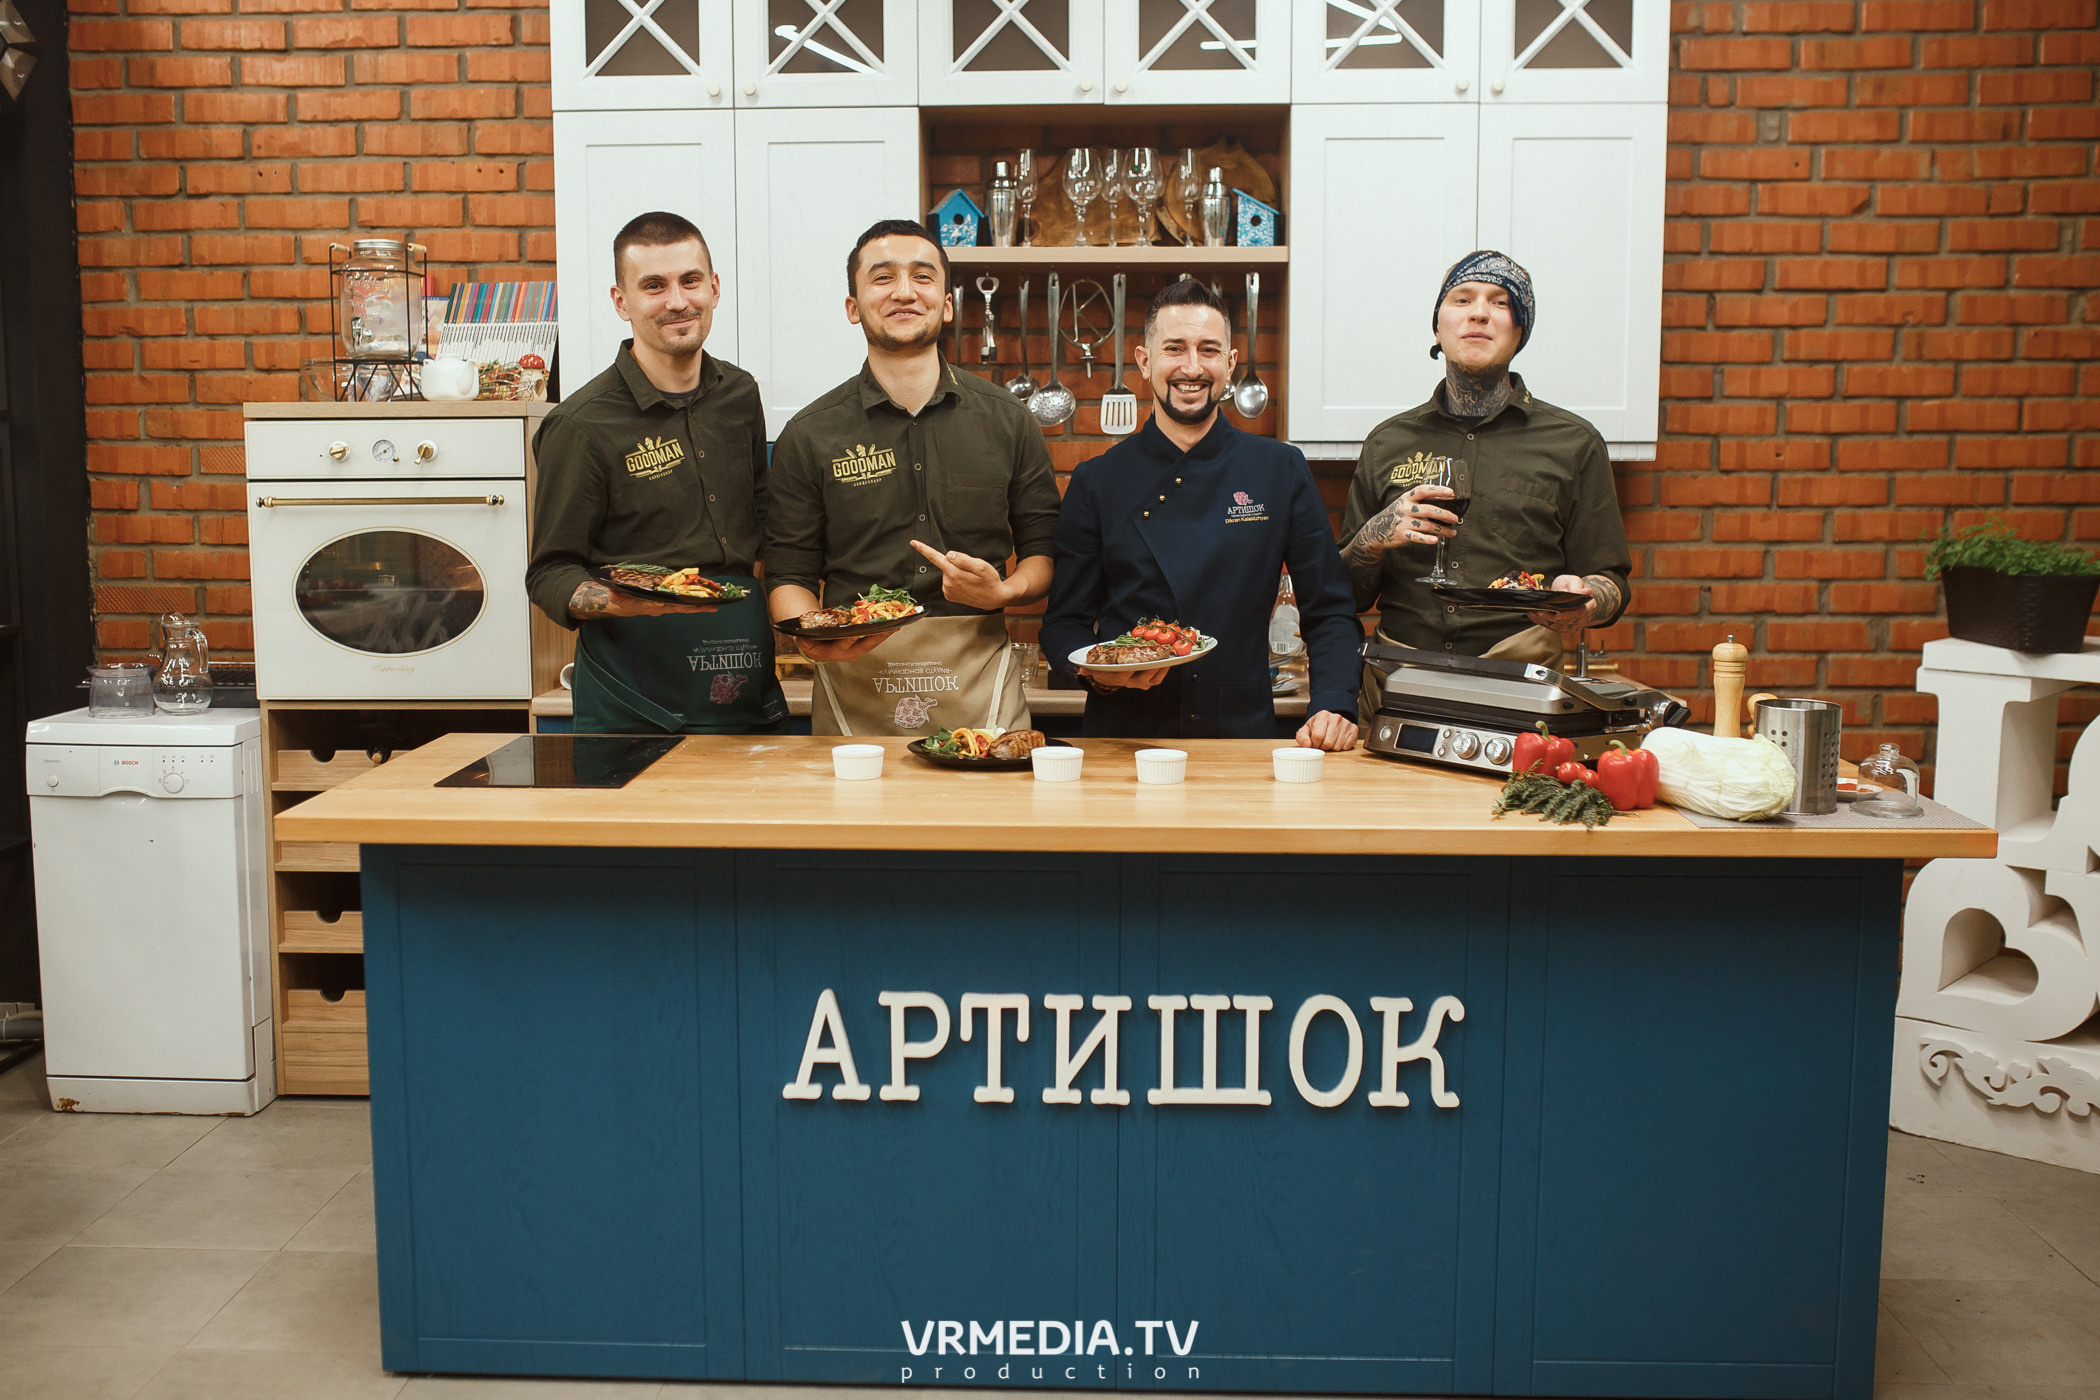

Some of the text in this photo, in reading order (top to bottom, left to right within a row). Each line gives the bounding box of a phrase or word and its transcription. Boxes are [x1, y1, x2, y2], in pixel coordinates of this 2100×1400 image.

[626, 442, 684, 473] GOODMAN
[832, 452, 896, 478] GOODMAN
[1227, 503, 1265, 515] АРТИШОК
[782, 987, 1466, 1108] АРТИШОК
